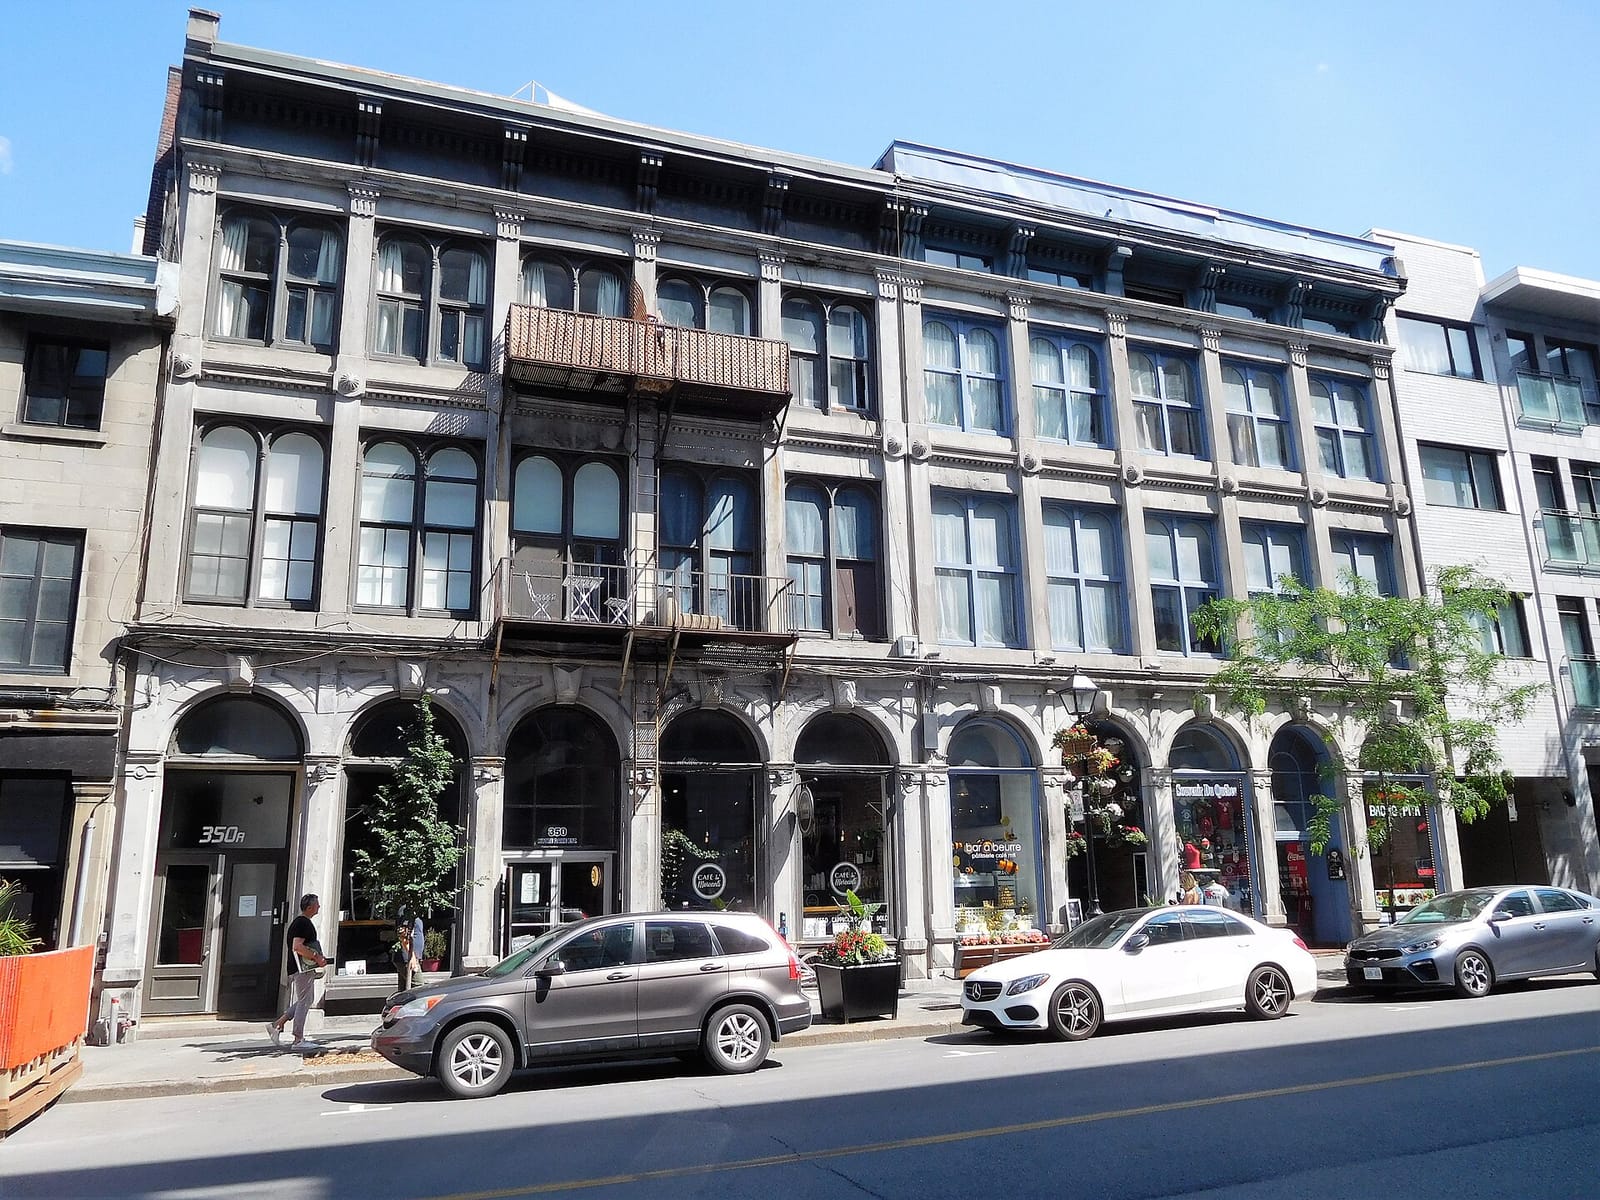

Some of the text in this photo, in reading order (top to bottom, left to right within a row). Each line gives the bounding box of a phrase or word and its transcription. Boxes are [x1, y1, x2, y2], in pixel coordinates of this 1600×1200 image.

[1203, 783, 1214, 797] Du
[547, 826, 567, 837] 350
[965, 842, 981, 852] bar
[992, 842, 1021, 852] beurre
